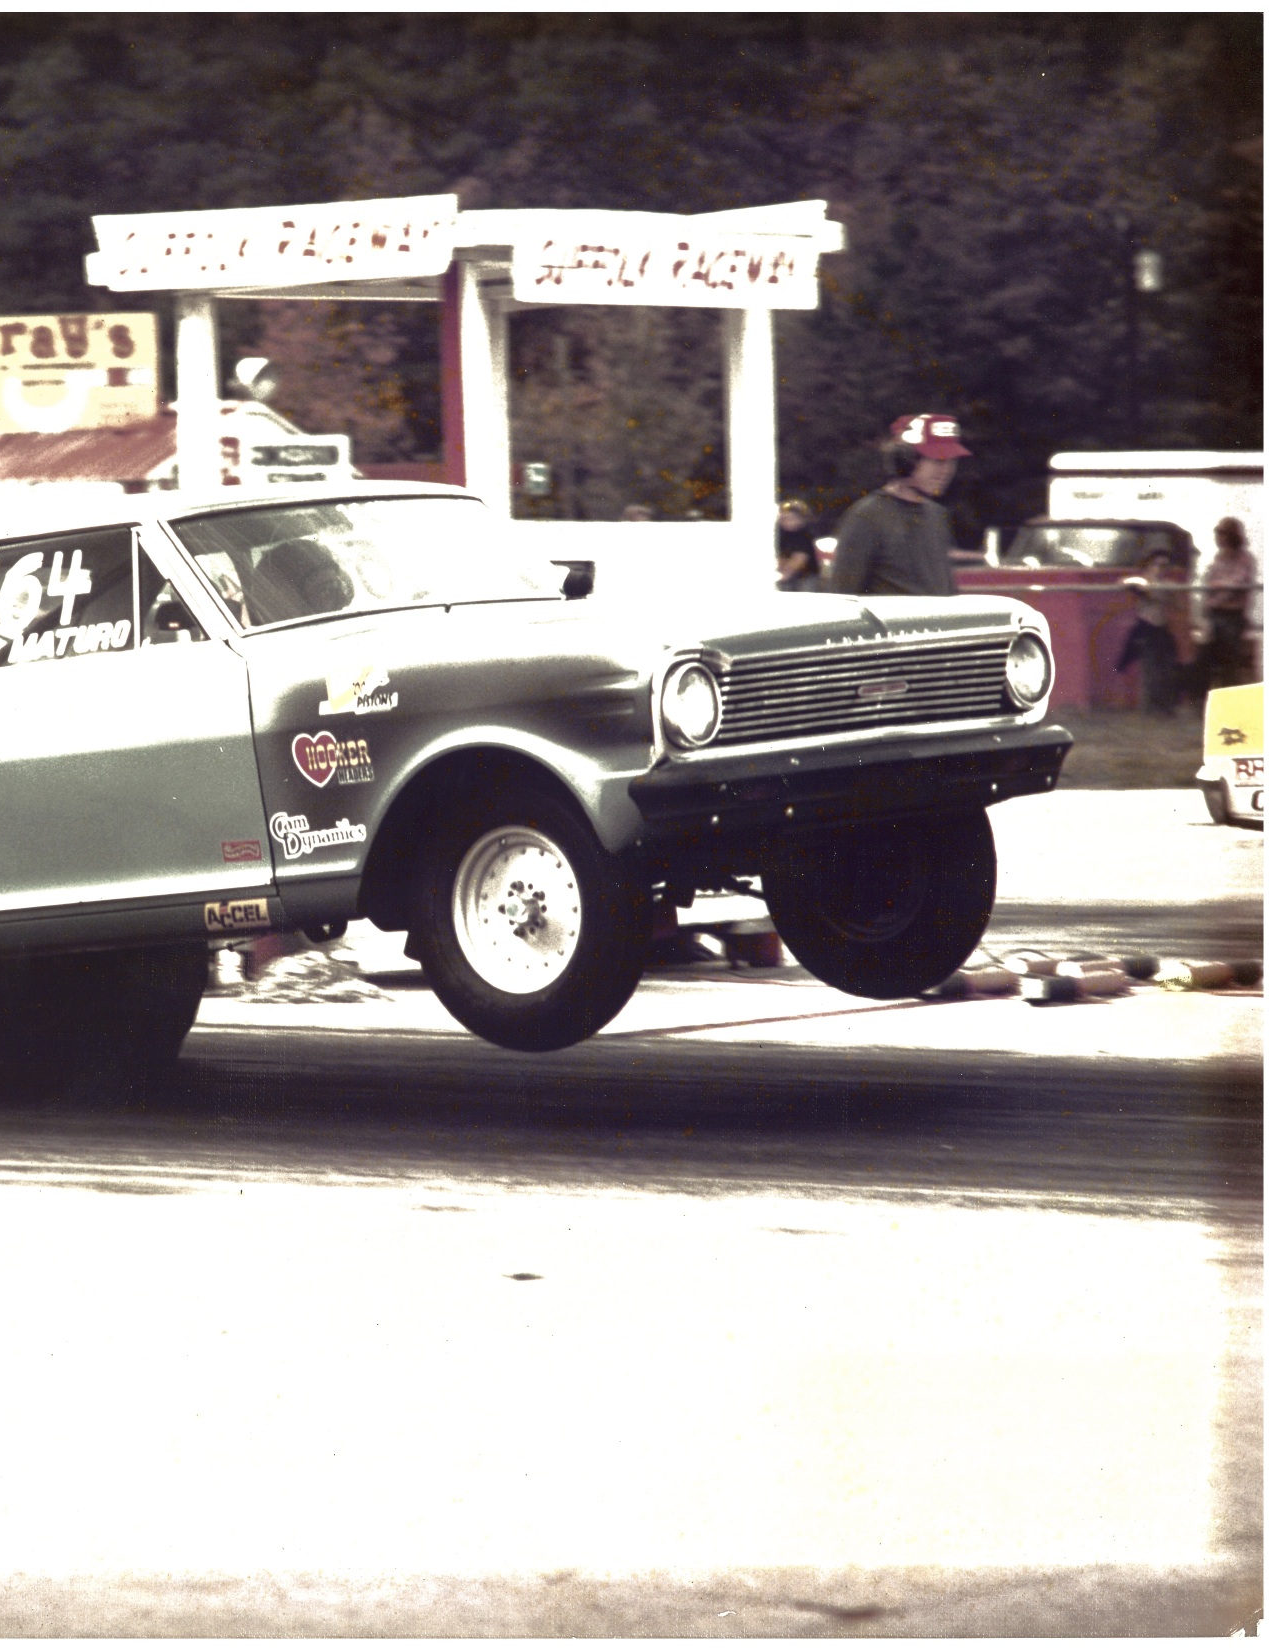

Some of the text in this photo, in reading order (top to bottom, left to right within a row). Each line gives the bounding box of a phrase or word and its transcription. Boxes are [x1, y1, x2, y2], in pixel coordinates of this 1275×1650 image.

[533, 238, 807, 292] SFFLK RACEWA
[305, 739, 372, 771] HOOKER
